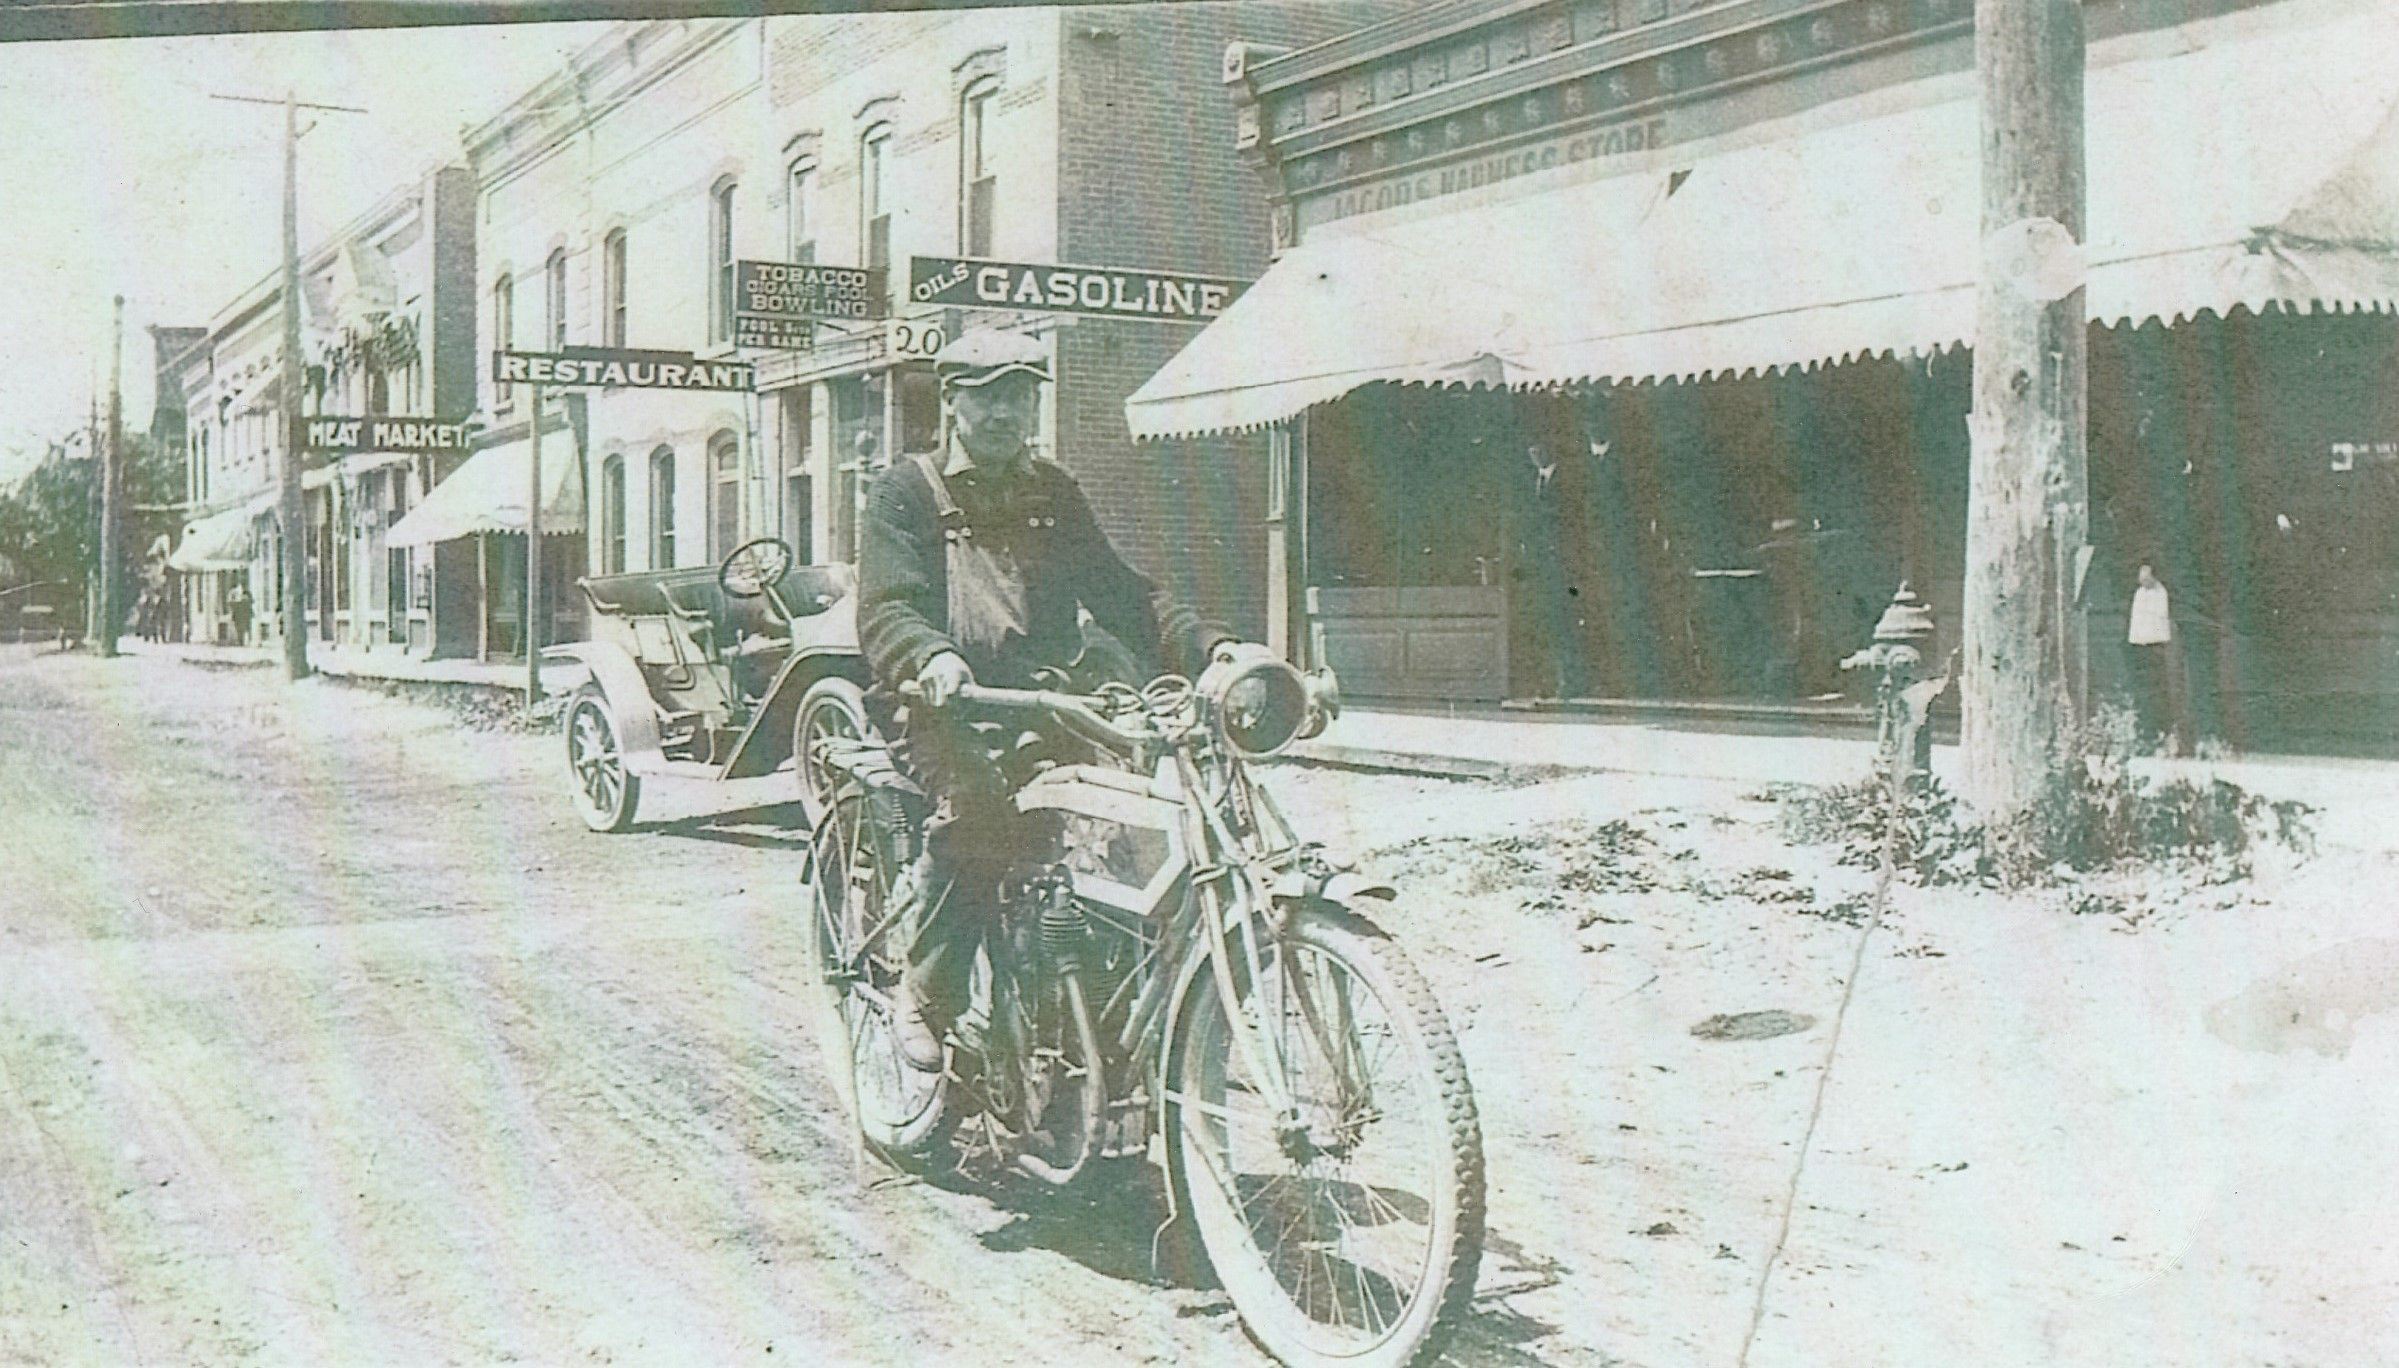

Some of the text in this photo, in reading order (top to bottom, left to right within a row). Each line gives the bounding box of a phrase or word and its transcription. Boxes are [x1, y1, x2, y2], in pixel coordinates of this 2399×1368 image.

[1568, 118, 1667, 162] STORE
[746, 279, 817, 297] CIGARS
[755, 265, 867, 287] TOBACCO
[914, 261, 1229, 316] OILS GASOLINE
[751, 294, 867, 317] BOWLING
[896, 325, 942, 355] 20
[500, 355, 752, 388] RESTAURANT
[308, 421, 464, 448] MEAT MARKET
